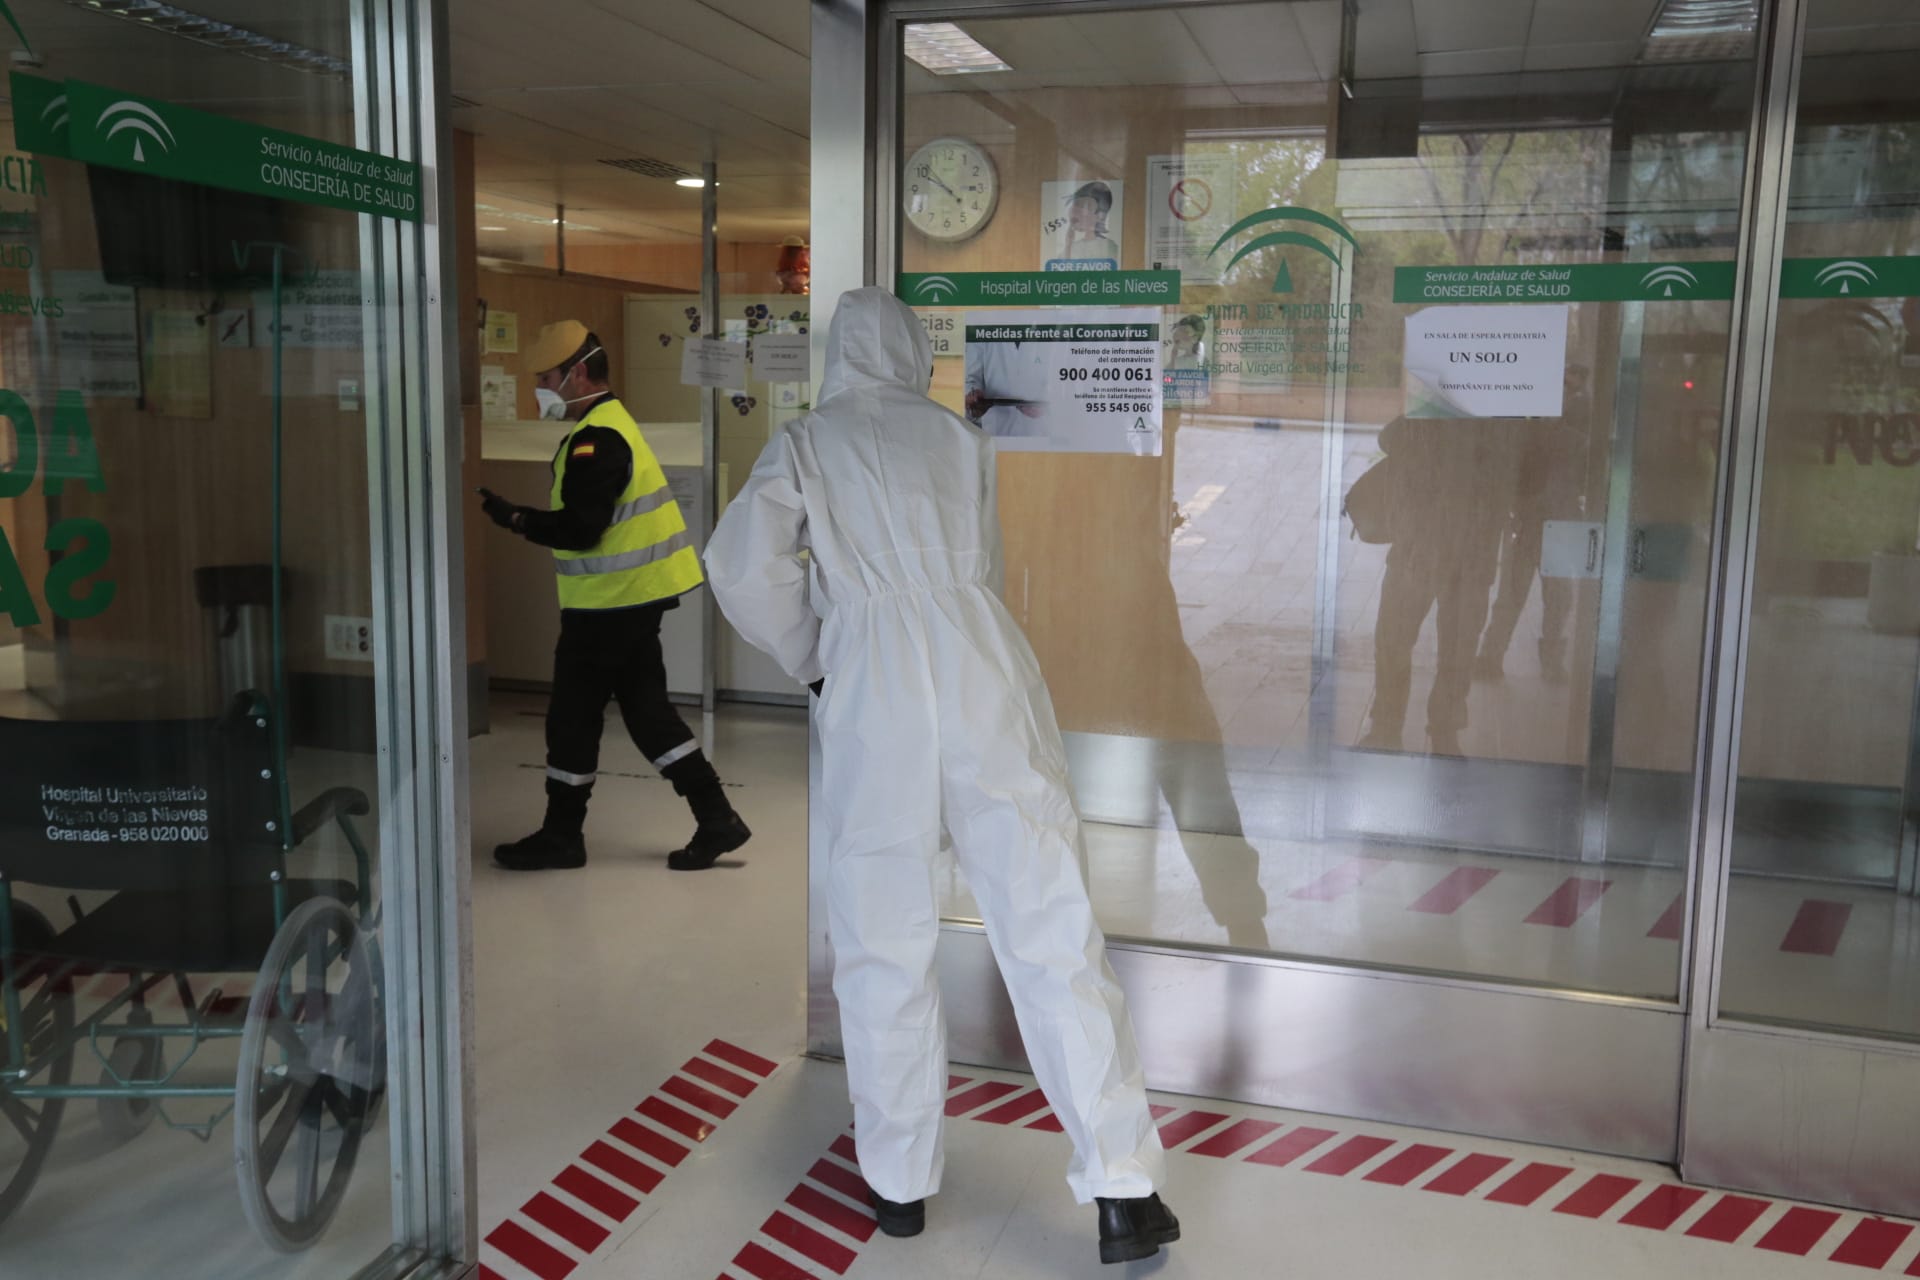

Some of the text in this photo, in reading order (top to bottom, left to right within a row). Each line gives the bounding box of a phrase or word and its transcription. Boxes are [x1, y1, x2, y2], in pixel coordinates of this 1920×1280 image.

[260, 137, 414, 187] Servicio Andaluz de Salud
[260, 163, 415, 212] CONSEJERÍA DE SALUD
[1051, 262, 1111, 272] POR FAVOR
[1425, 269, 1571, 282] Servicio Andaluz de Salud
[981, 278, 1169, 298] Hospital Virgen de las Nieves
[1424, 281, 1569, 297] CONSEJERÍA DE SALUD
[1203, 303, 1249, 320] JUNTA
[1256, 303, 1275, 320] DE
[975, 327, 1148, 339] Medidas frente al Coronavirus
[1071, 347, 1154, 355] Teléfono de información
[1450, 352, 1518, 364] UN SOLO
[1059, 368, 1152, 381] 900 400 061
[1246, 361, 1284, 376] Virgen
[1494, 383, 1511, 391] POR
[1512, 382, 1534, 391] NIÑO
[1086, 402, 1153, 412] 955 545 060
[41, 784, 208, 805] Hospital Universitario
[98, 808, 119, 824] de
[122, 807, 148, 823] las
[151, 806, 208, 822] Nieves
[46, 825, 110, 842] Granada
